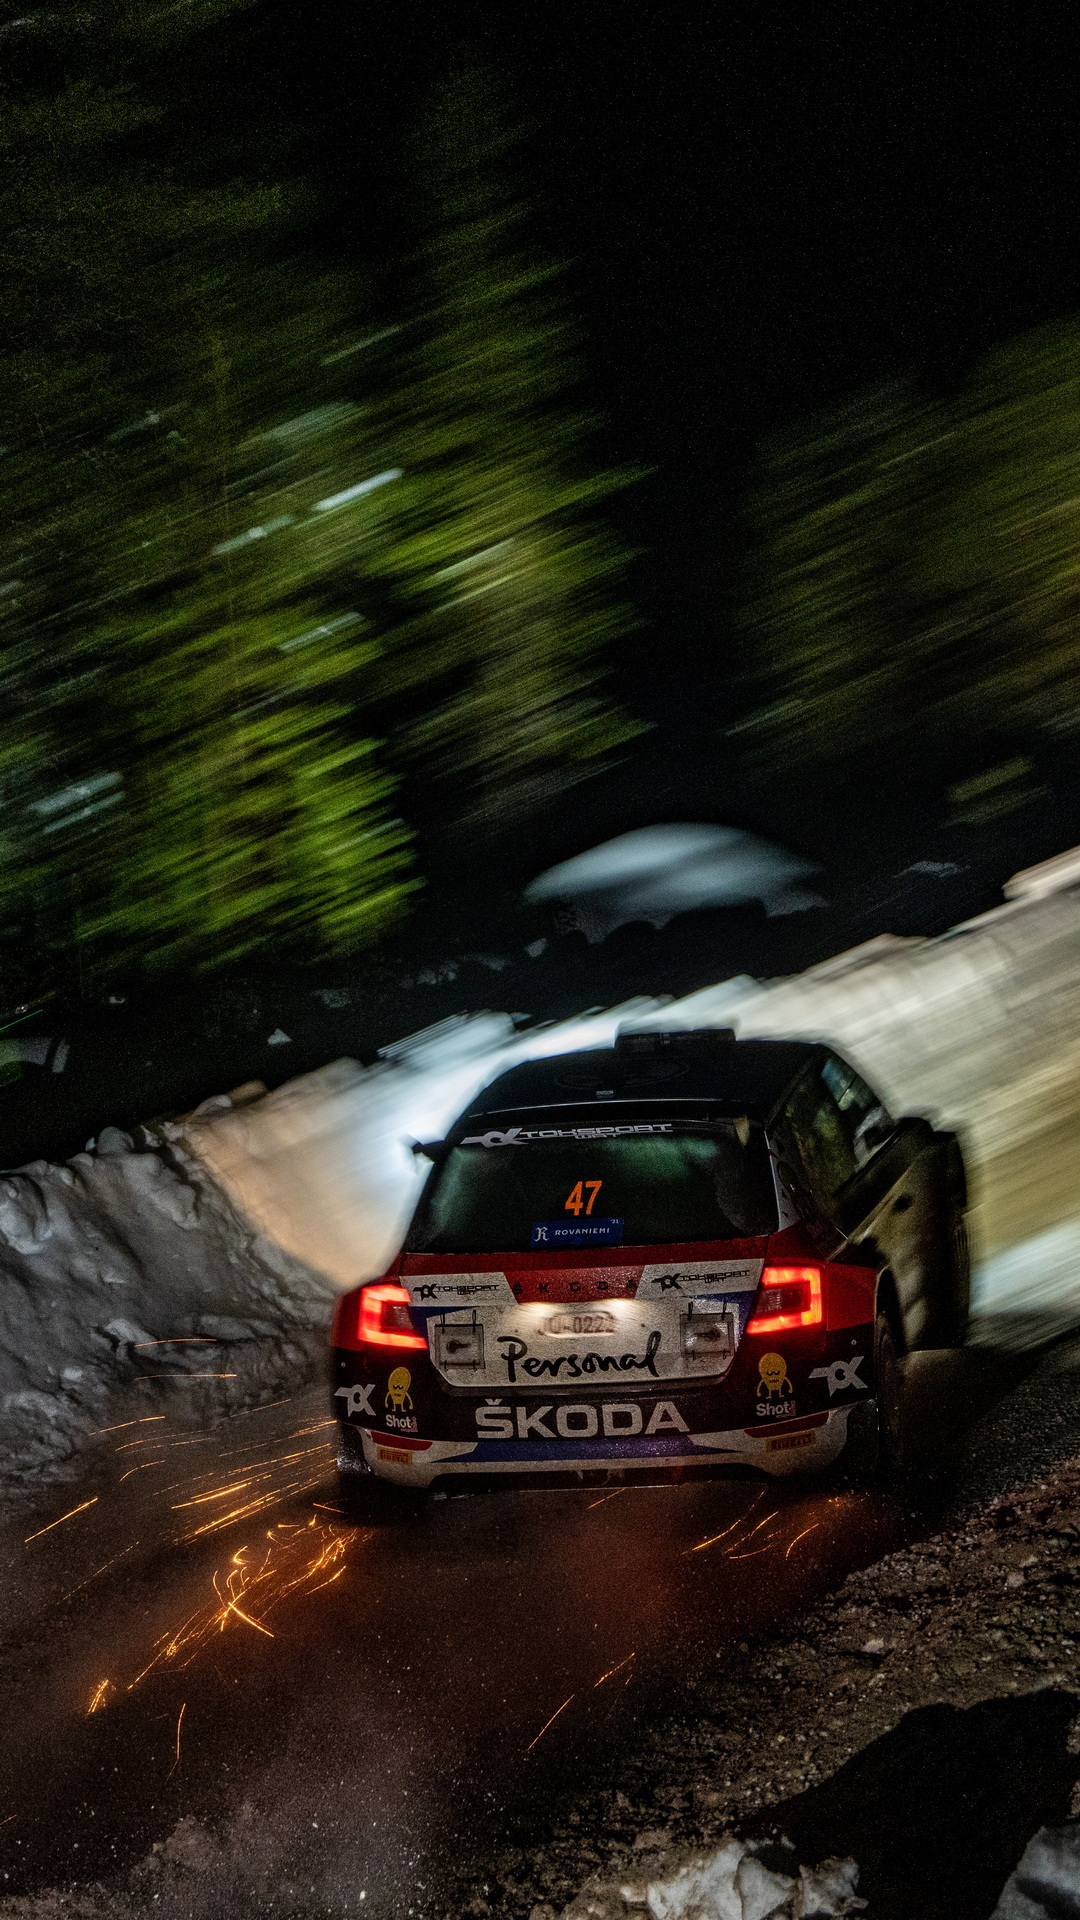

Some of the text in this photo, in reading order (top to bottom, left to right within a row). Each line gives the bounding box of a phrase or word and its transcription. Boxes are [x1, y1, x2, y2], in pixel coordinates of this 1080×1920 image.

[564, 1180, 602, 1216] 47
[554, 1227, 610, 1236] ROVANIEMI
[497, 1330, 662, 1383] Personal
[385, 1414, 412, 1429] Shot
[475, 1398, 690, 1439] ŠKODA
[756, 1400, 790, 1417] Shot
